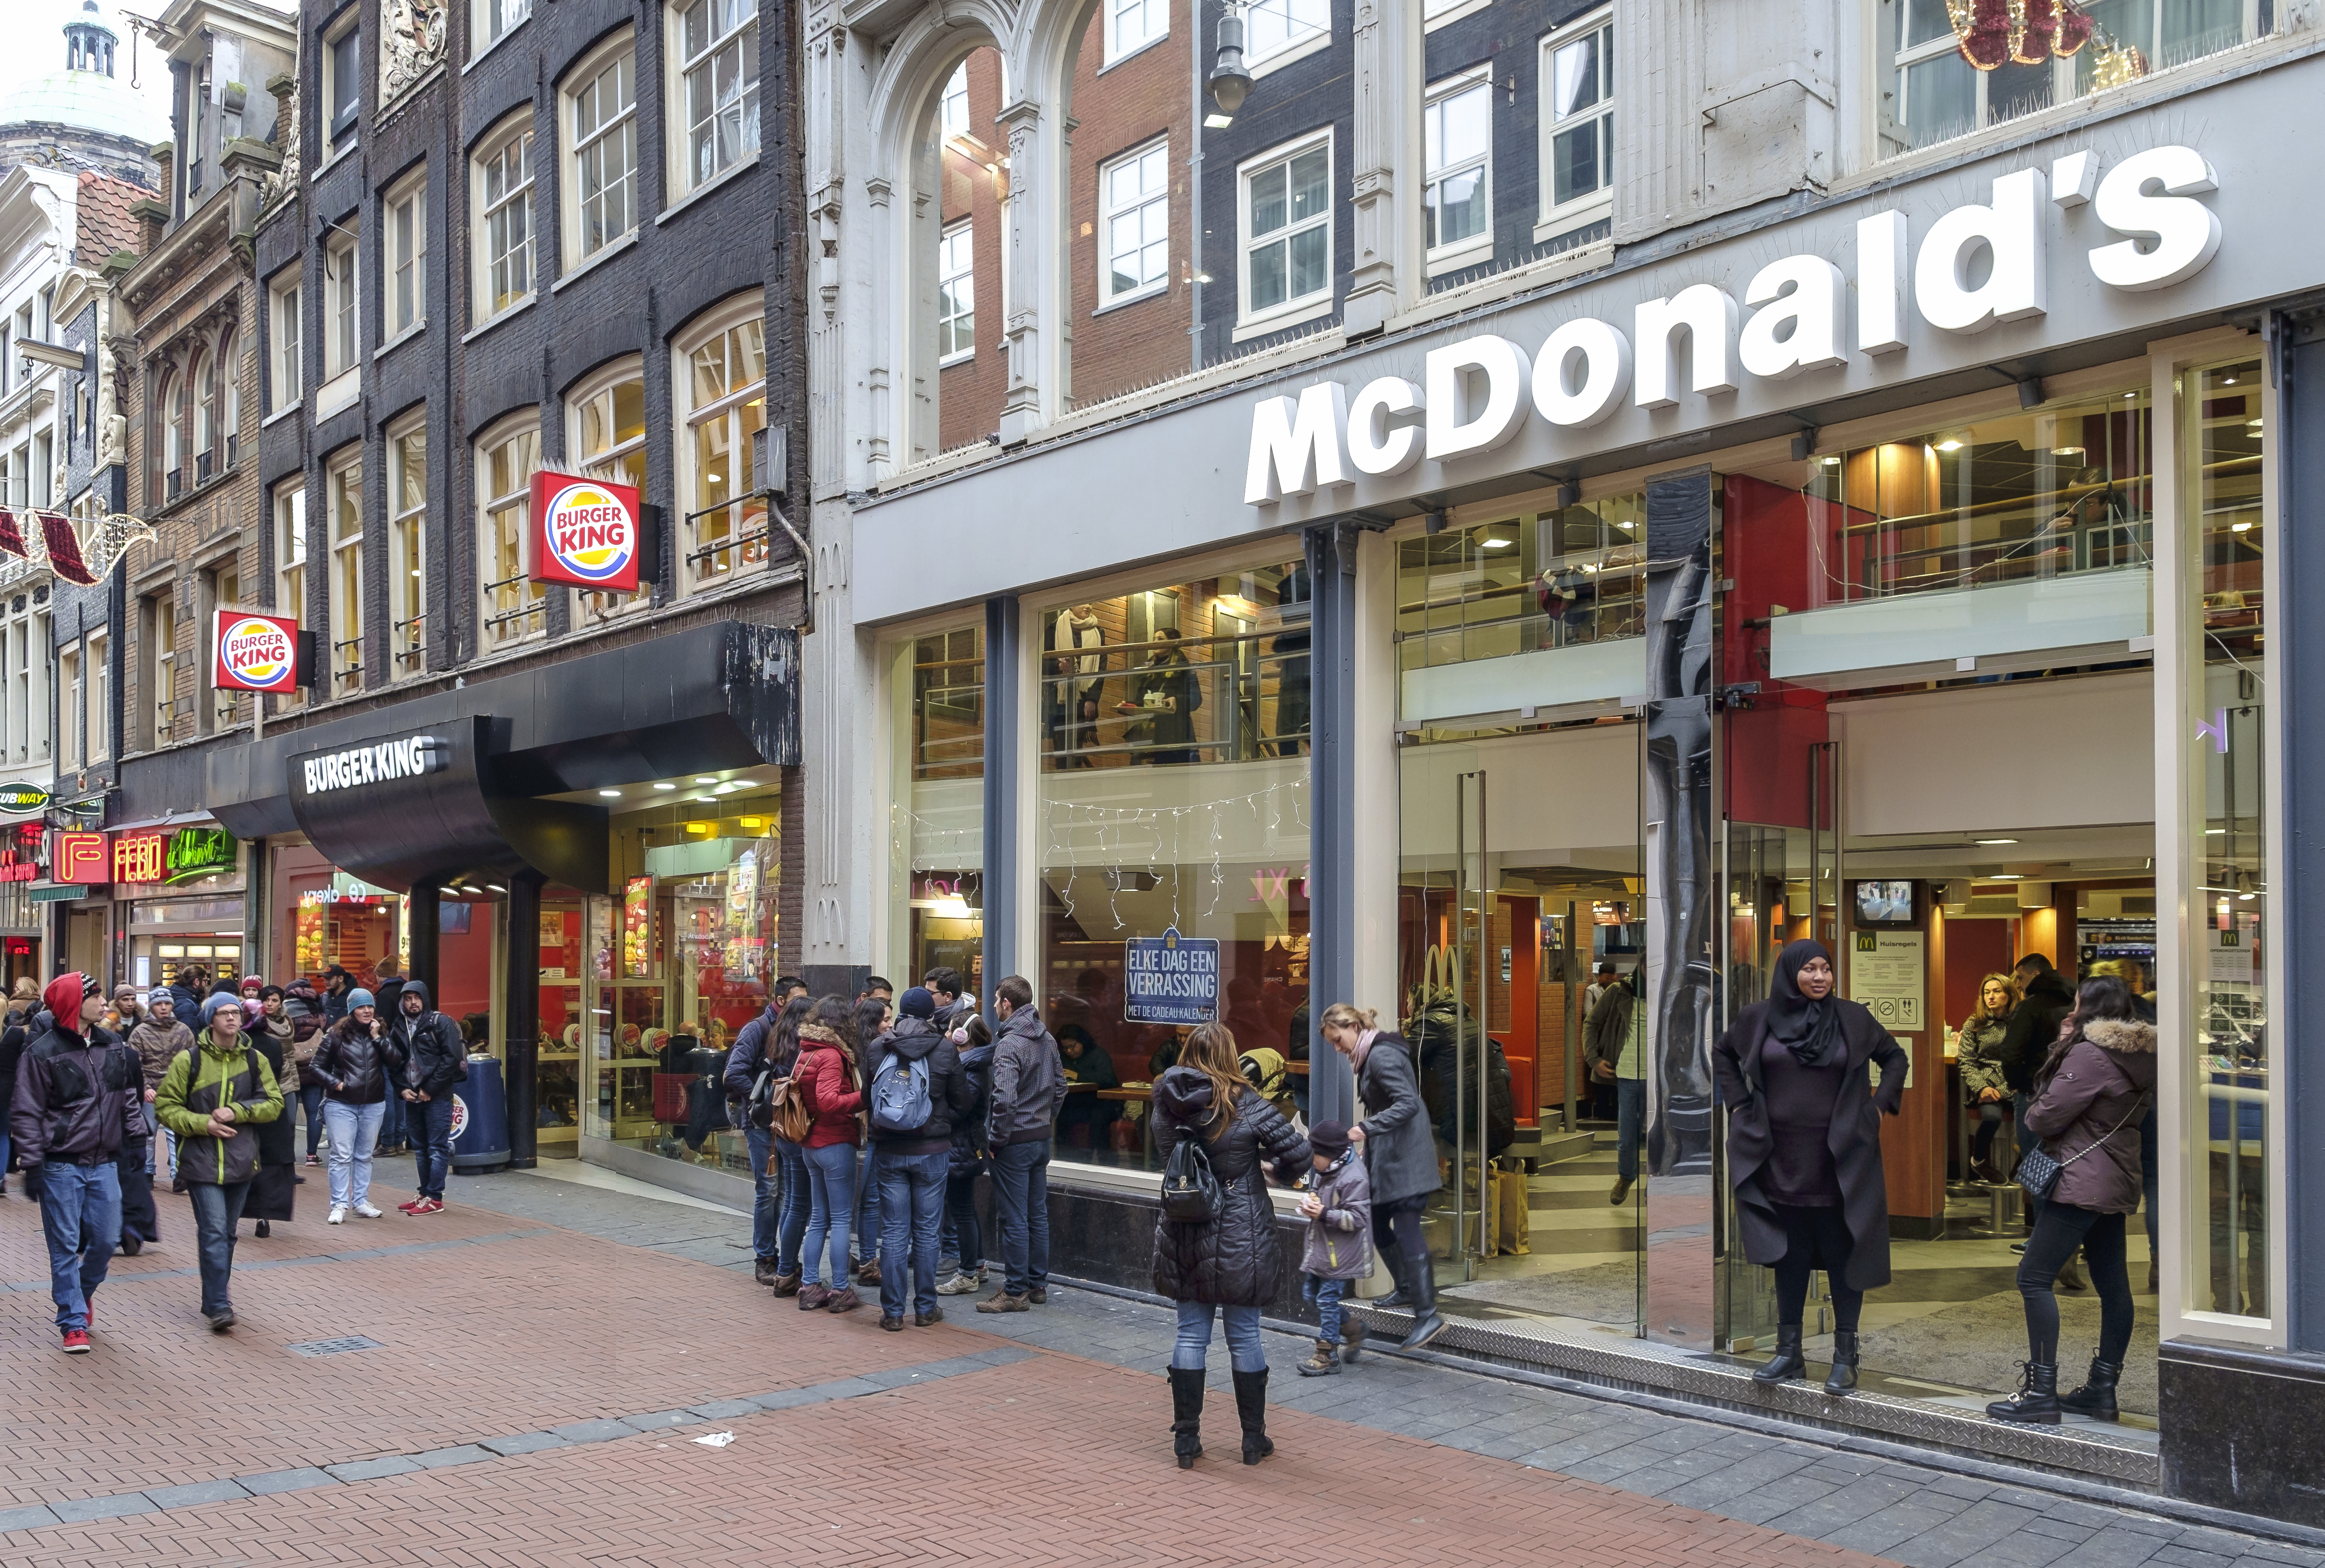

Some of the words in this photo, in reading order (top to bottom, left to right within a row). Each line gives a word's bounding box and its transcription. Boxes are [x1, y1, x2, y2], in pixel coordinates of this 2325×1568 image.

[1244, 144, 2222, 507] McDonald's
[557, 507, 621, 529] BURGER
[560, 523, 624, 554] KING
[231, 634, 283, 652] BURGER
[233, 646, 285, 669] KING
[304, 746, 374, 794] BURGER
[375, 736, 427, 781] KING
[115, 834, 160, 883] FEBO
[1129, 949, 1159, 971] ELKE
[1161, 950, 1187, 972] DAG
[1191, 951, 1215, 972] EEN
[1129, 972, 1215, 998] VERRASSING
[1128, 1005, 1140, 1017] MET
[1142, 1005, 1151, 1017] DE
[1152, 1006, 1178, 1019] CADEAU
